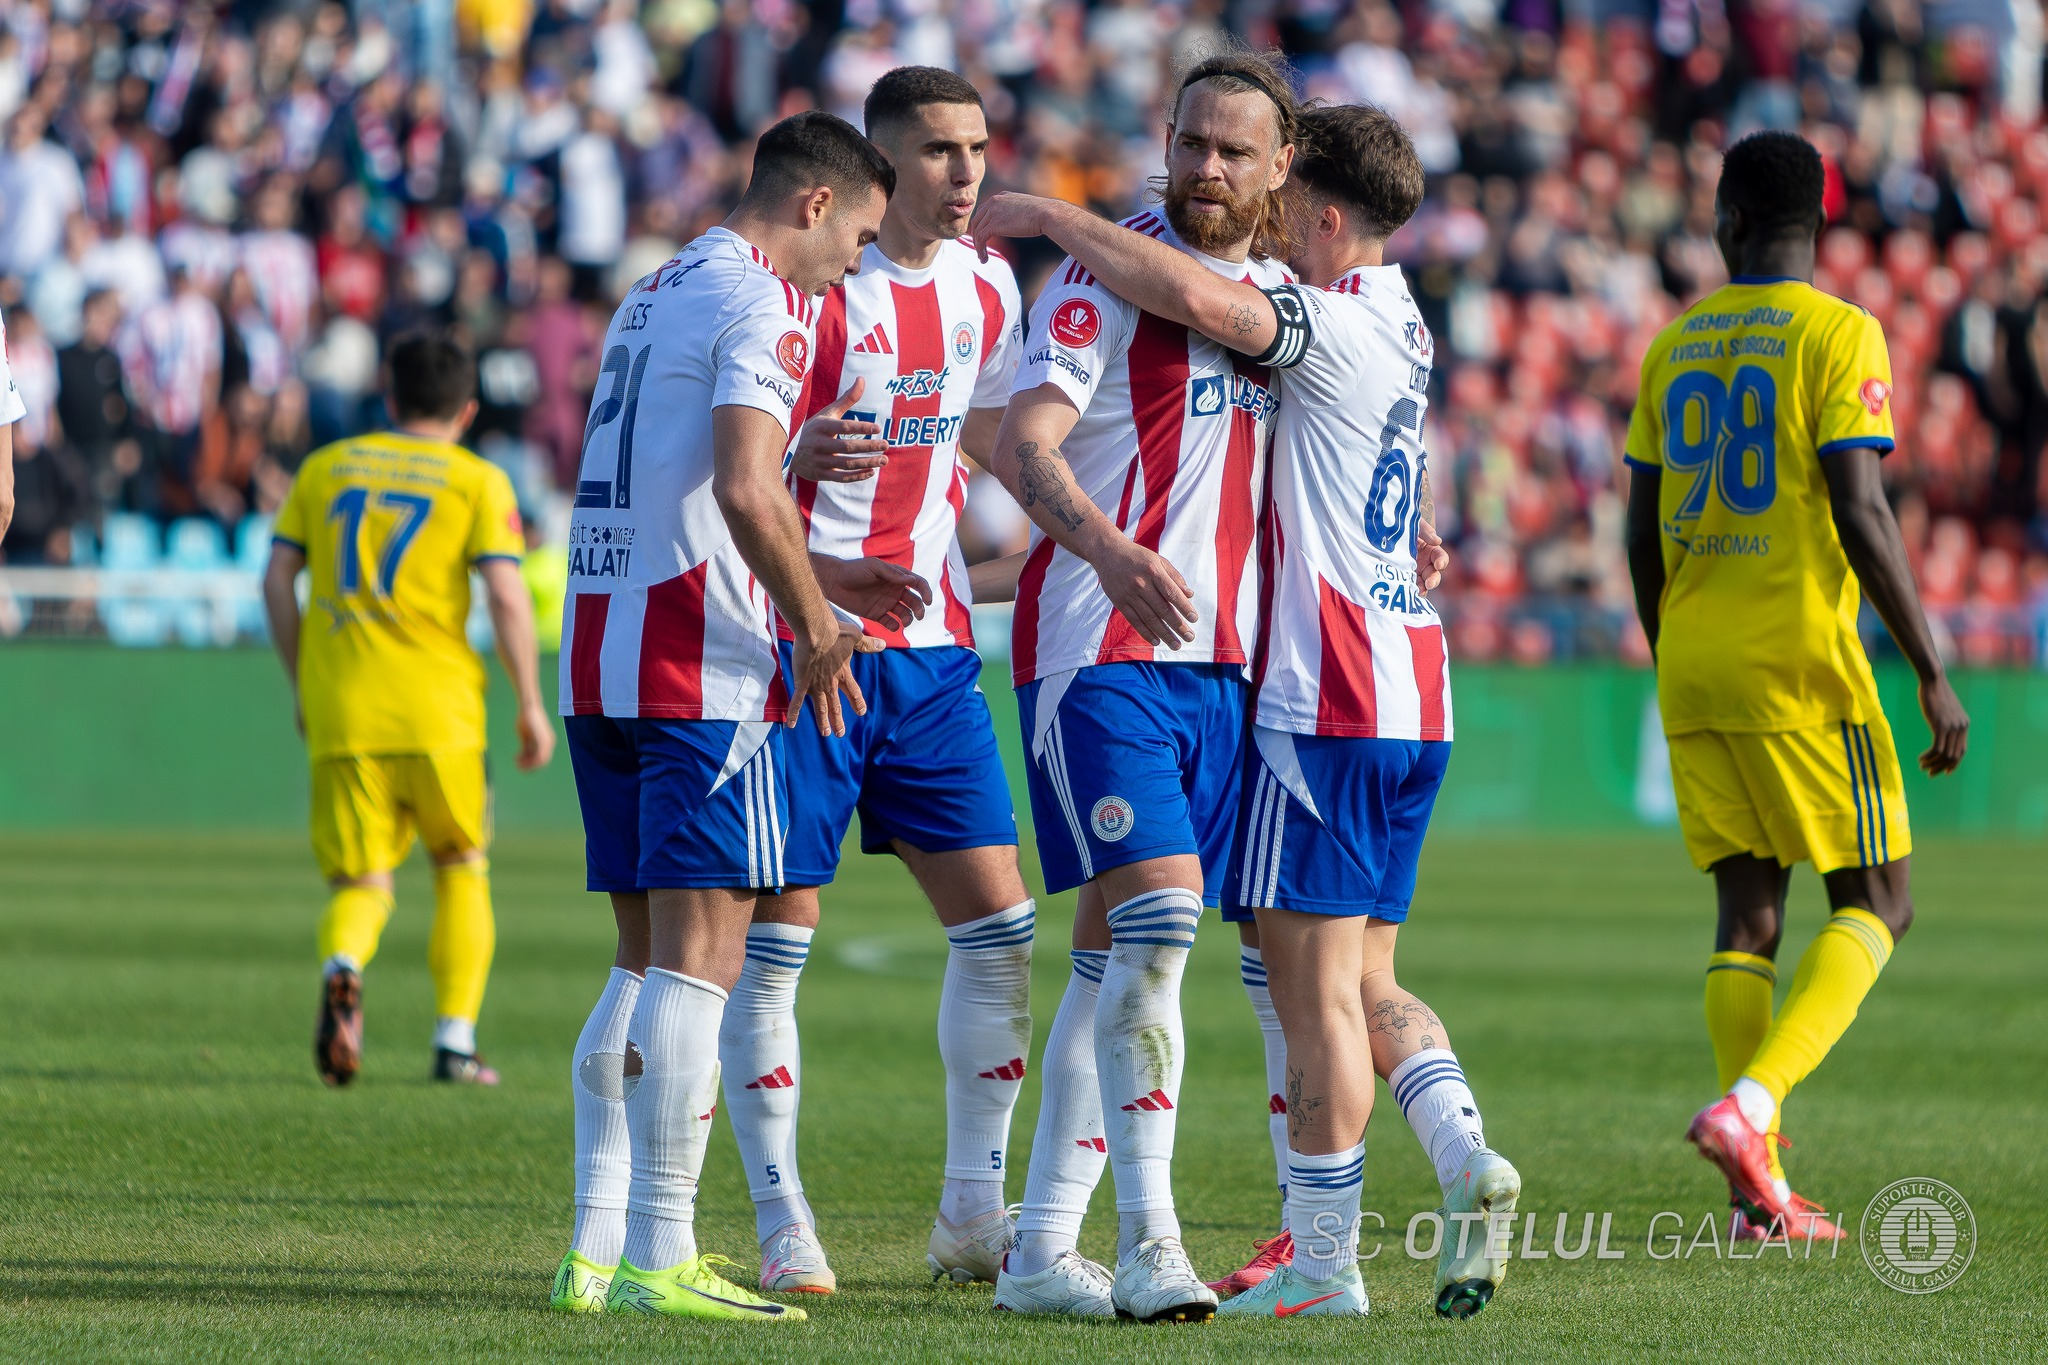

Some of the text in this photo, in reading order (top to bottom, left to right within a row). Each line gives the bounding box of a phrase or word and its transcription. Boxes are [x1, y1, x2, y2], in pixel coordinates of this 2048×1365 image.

[1029, 350, 1090, 385] VALGRIG
[574, 344, 651, 509] 21
[1662, 364, 1777, 521] 98
[326, 486, 431, 598] 17
[1369, 581, 1437, 615] GALA
[766, 1164, 781, 1185] 5
[990, 1150, 1002, 1170] 5
